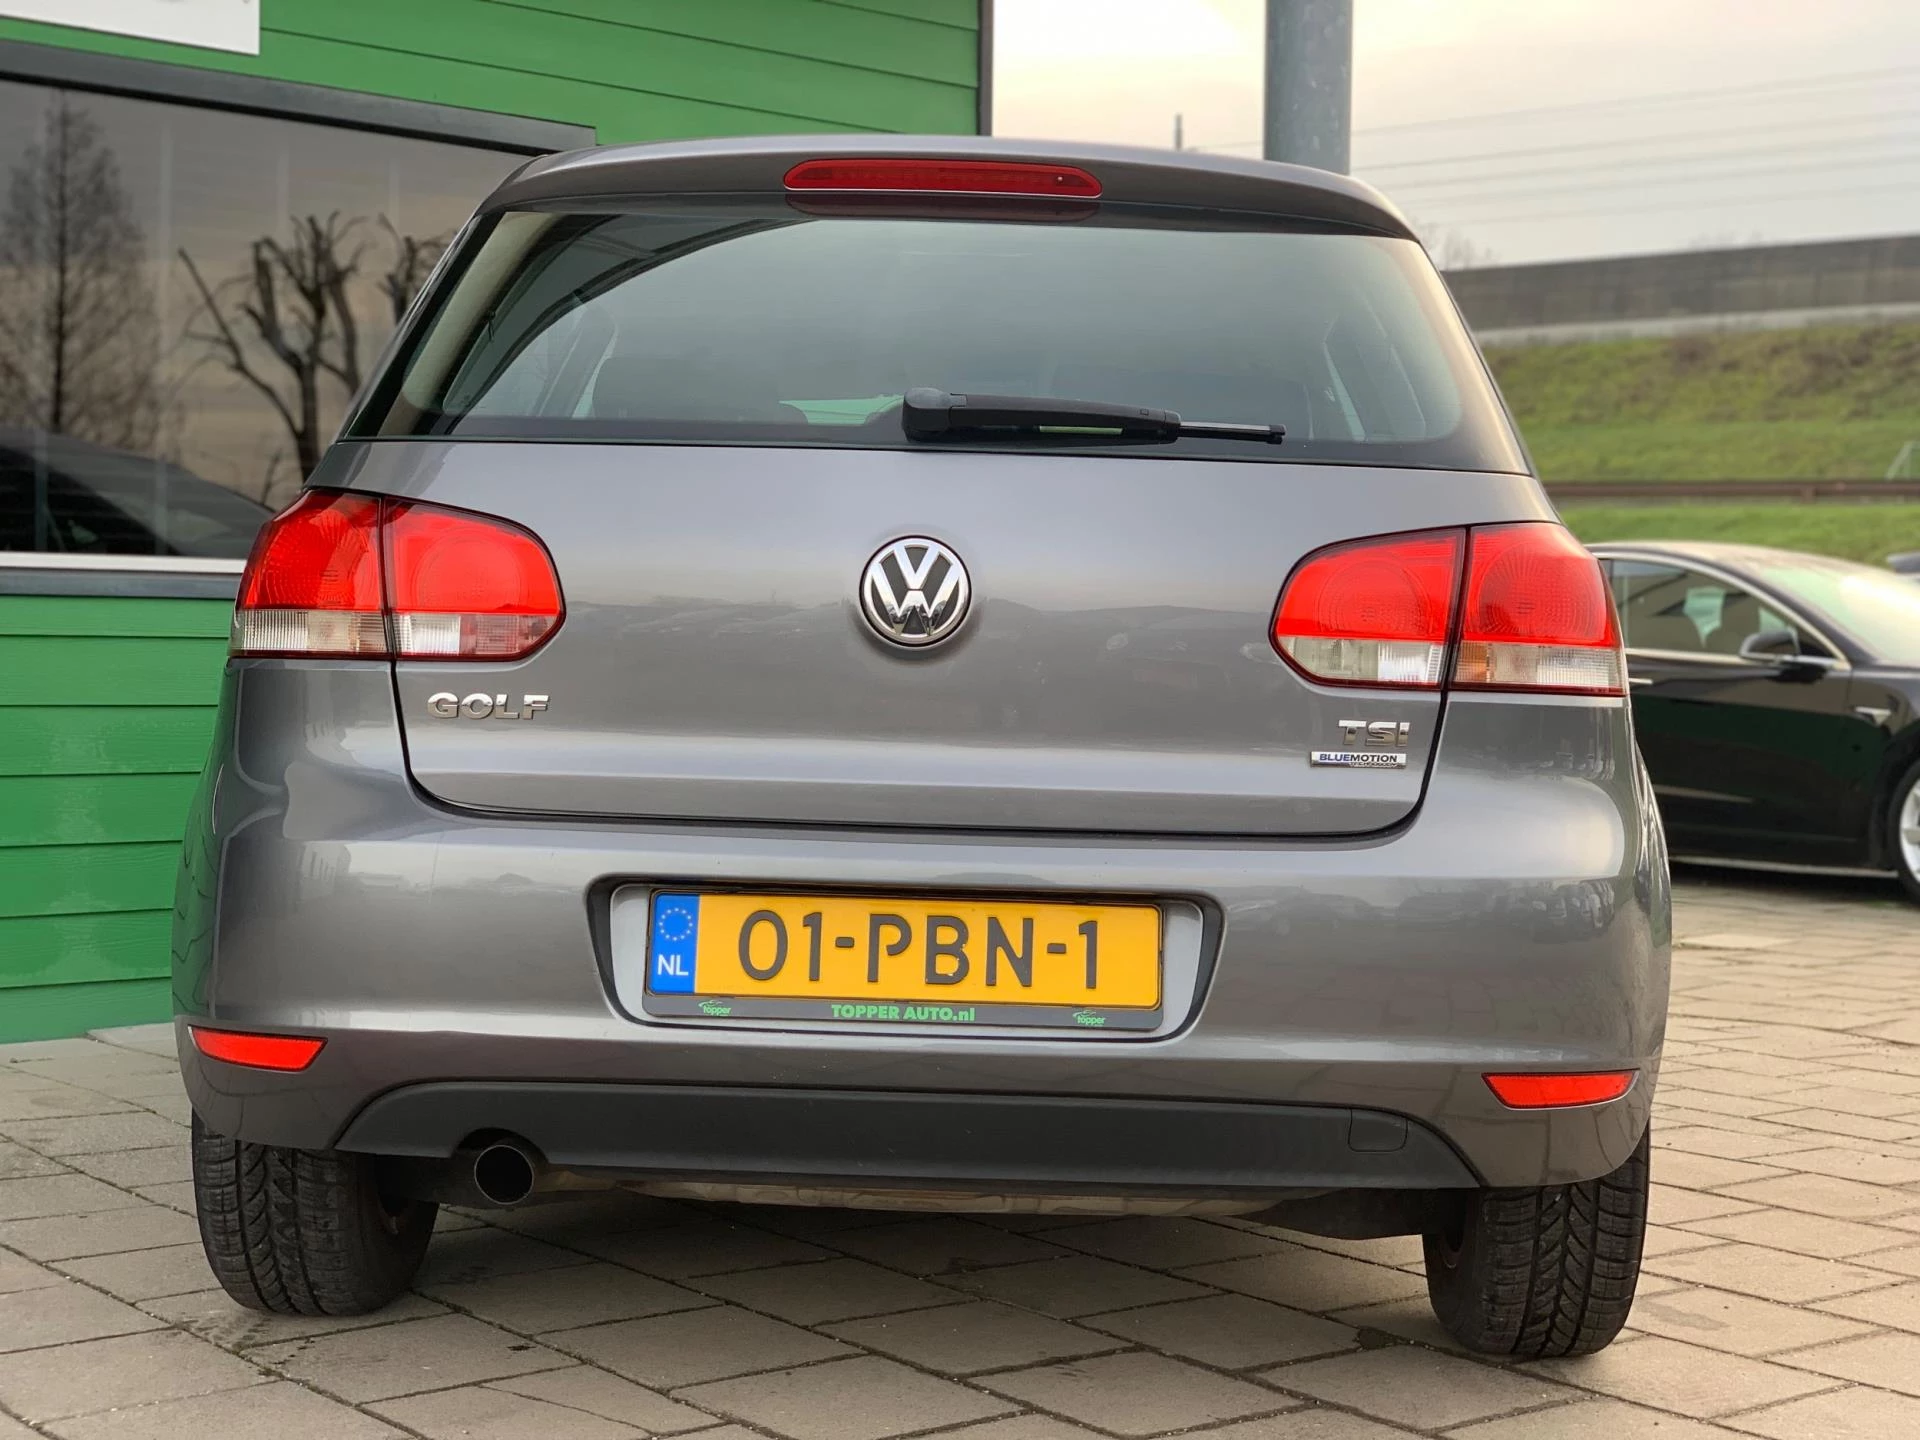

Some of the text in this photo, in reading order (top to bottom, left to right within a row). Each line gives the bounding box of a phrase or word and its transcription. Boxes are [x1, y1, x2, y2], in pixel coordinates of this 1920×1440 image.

[427, 692, 549, 720] GOLF
[1338, 719, 1410, 747] TSI
[1319, 753, 1398, 763] BLUEMOTION
[738, 910, 1098, 989] 01-PBN-1
[657, 953, 689, 976] NL
[831, 1004, 975, 1021] TOPPER AUTO.nl
